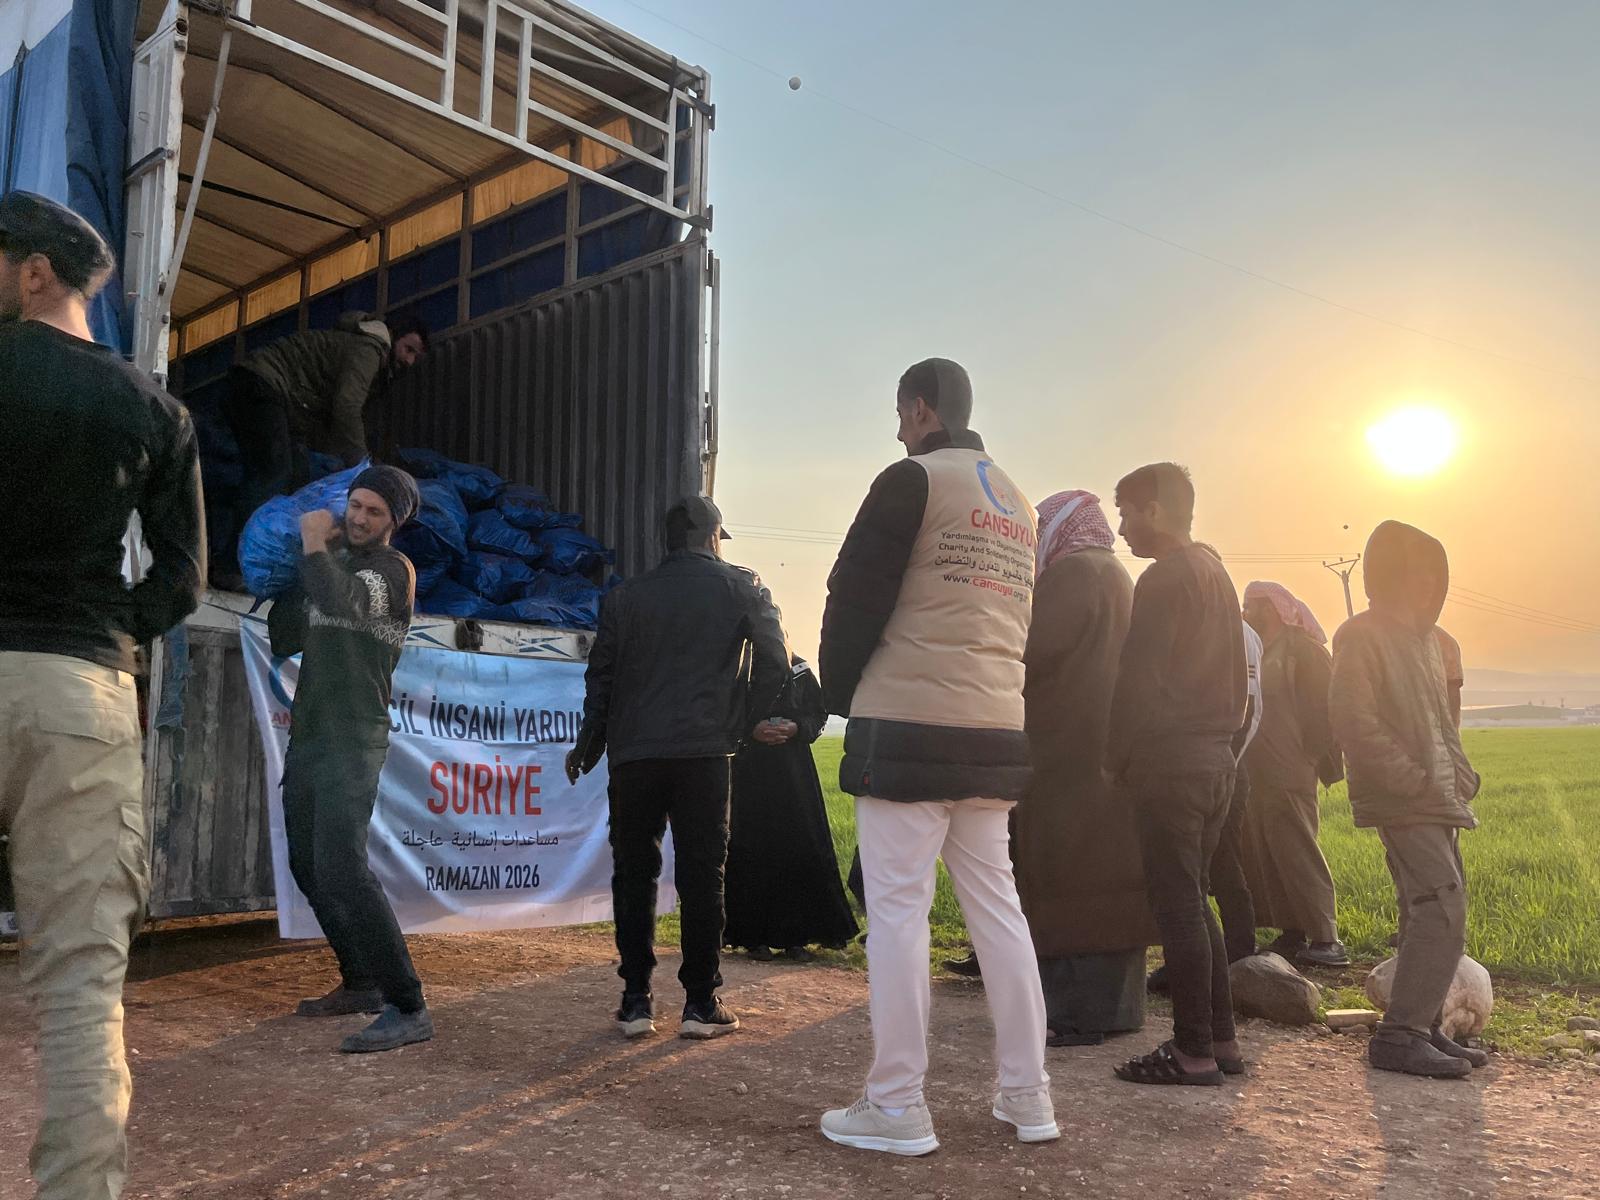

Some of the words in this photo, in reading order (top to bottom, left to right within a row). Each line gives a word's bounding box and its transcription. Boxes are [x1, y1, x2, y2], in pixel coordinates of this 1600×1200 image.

[941, 531, 989, 544] Yardımlaşma
[971, 508, 1033, 547] CANSUYU
[938, 542, 969, 553] Charity
[970, 545, 985, 554] And
[934, 555, 977, 569] والتضامن
[390, 692, 424, 736] CİL
[429, 695, 505, 742] İNSANİ
[427, 755, 543, 817] SURİYE
[402, 829, 444, 851] عاجلة
[450, 830, 498, 851] إنسانية
[502, 829, 559, 847] مساعدات
[425, 864, 501, 892] RAMAZAN
[504, 863, 541, 889] 2026
